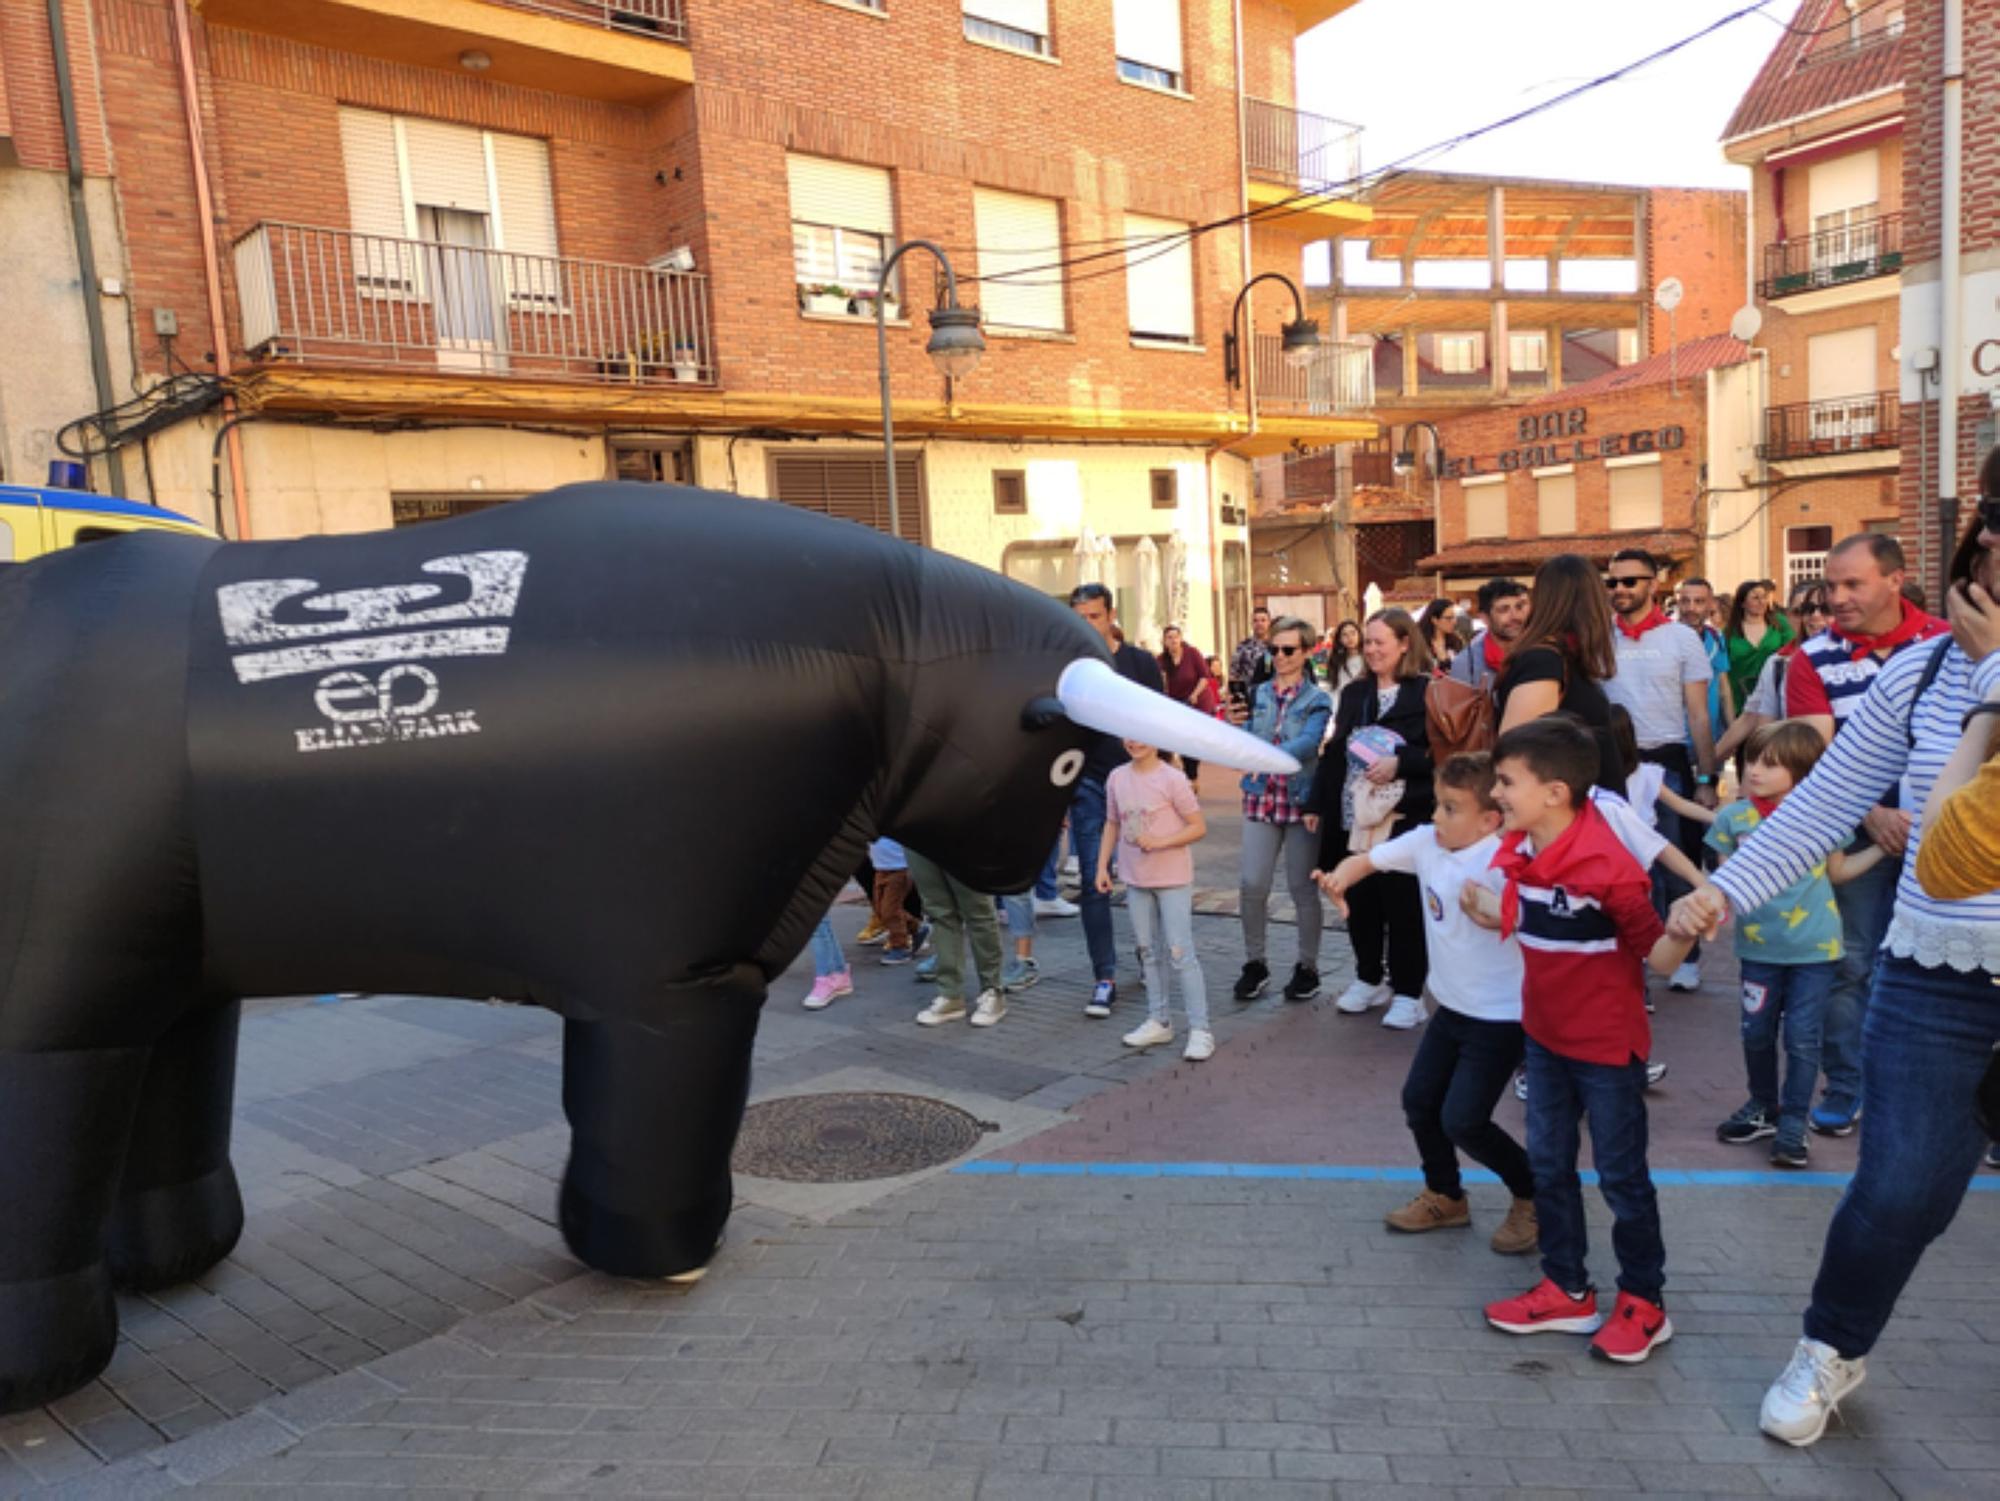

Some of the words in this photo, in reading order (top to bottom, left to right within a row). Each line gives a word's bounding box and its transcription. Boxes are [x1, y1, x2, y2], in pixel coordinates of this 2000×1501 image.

[1517, 407, 1588, 442] BAR
[1441, 455, 1486, 479] EL
[1497, 425, 1684, 471] GALLEGO
[397, 709, 481, 741] PARK
